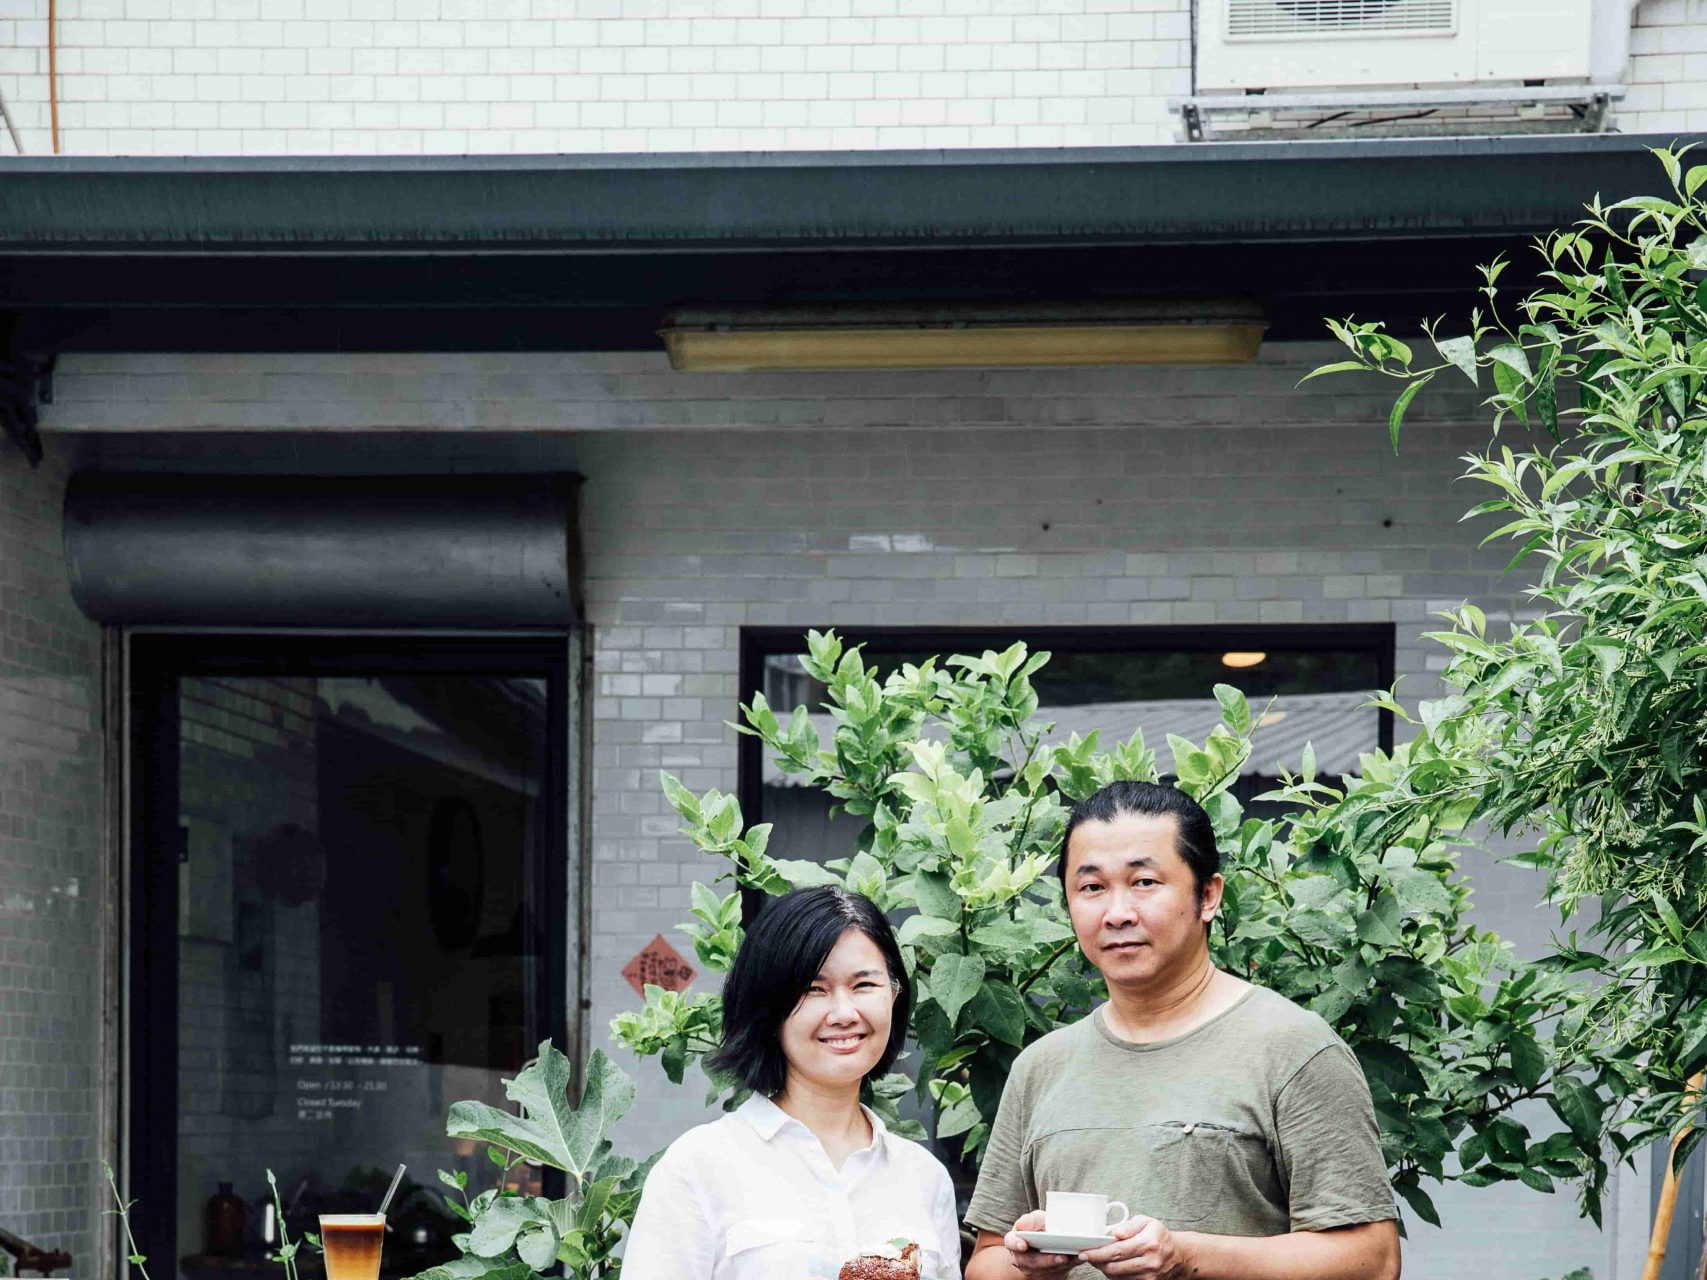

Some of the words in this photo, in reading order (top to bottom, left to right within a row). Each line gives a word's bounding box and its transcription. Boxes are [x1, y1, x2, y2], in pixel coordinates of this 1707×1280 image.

[297, 1080, 320, 1091] Open
[298, 1097, 326, 1107] Closed
[328, 1097, 362, 1110] Tuesday
